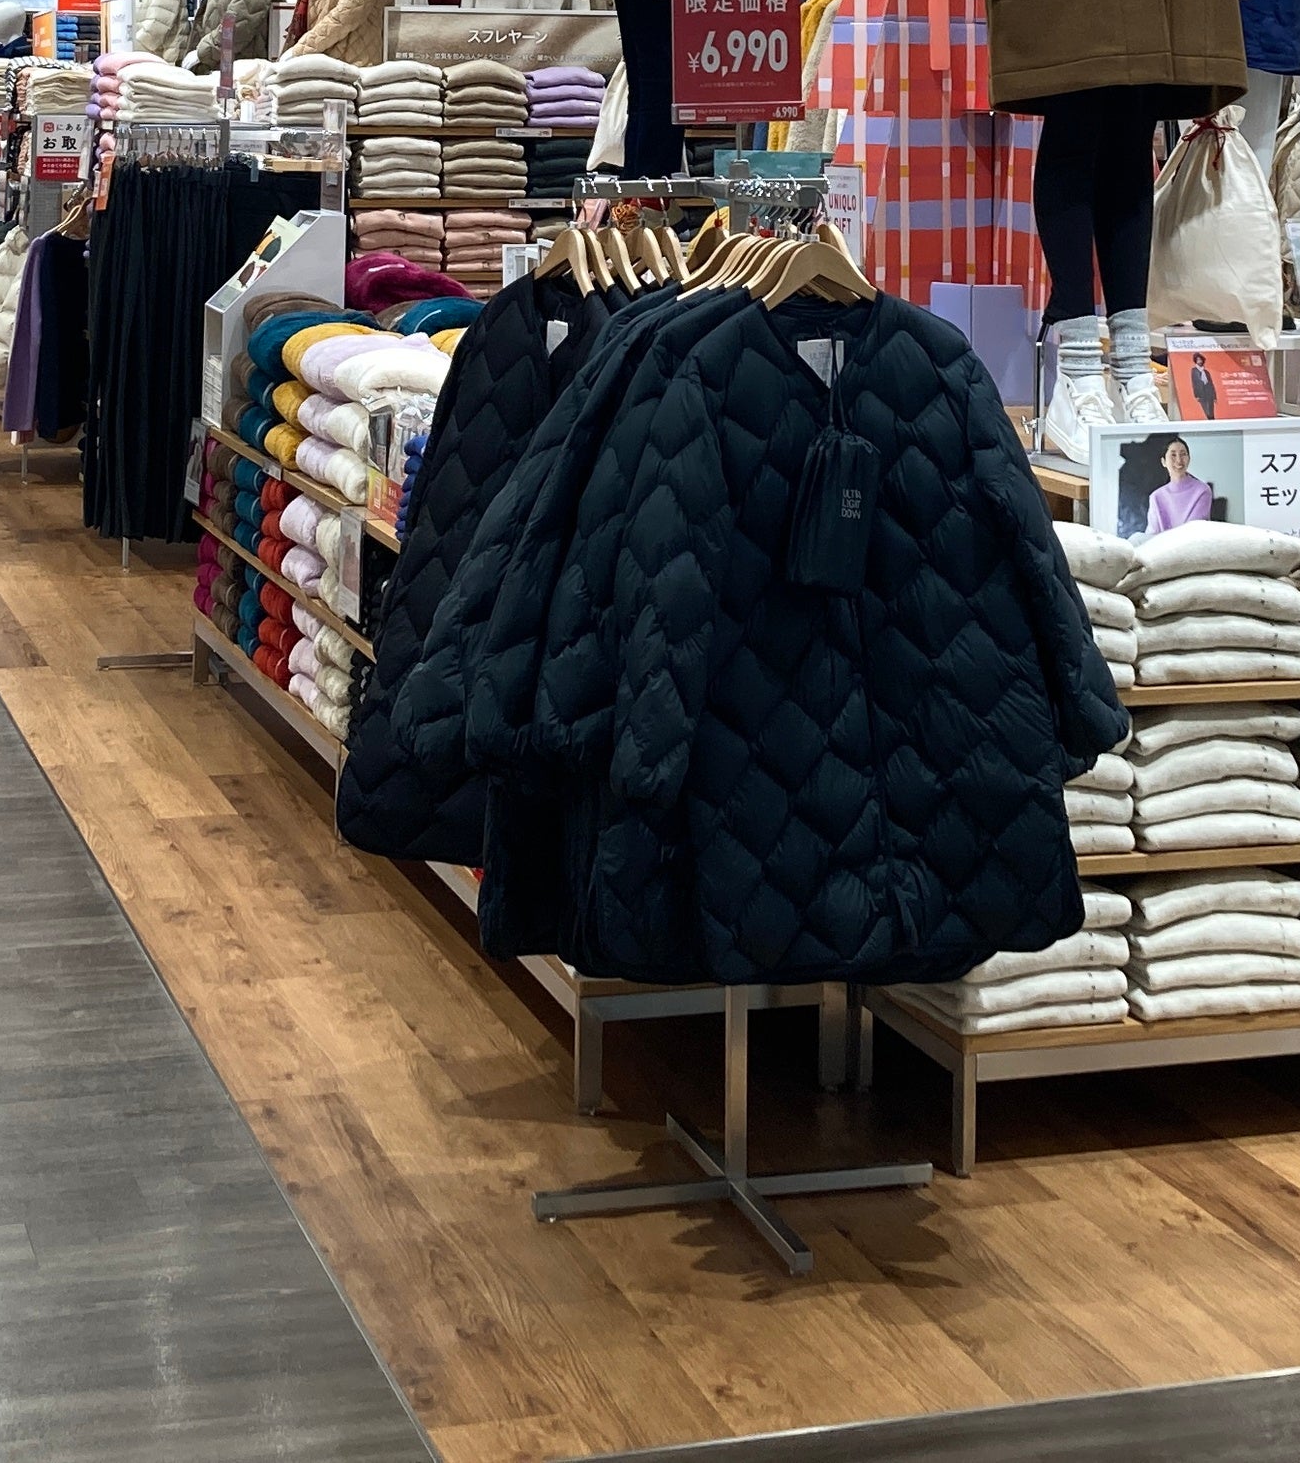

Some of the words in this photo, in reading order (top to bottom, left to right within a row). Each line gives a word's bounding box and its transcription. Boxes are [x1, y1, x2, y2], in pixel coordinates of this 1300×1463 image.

[466, 28, 548, 44] スフレヤーン
[687, 29, 789, 77] ¥6,990
[828, 193, 857, 213] UNIQLO
